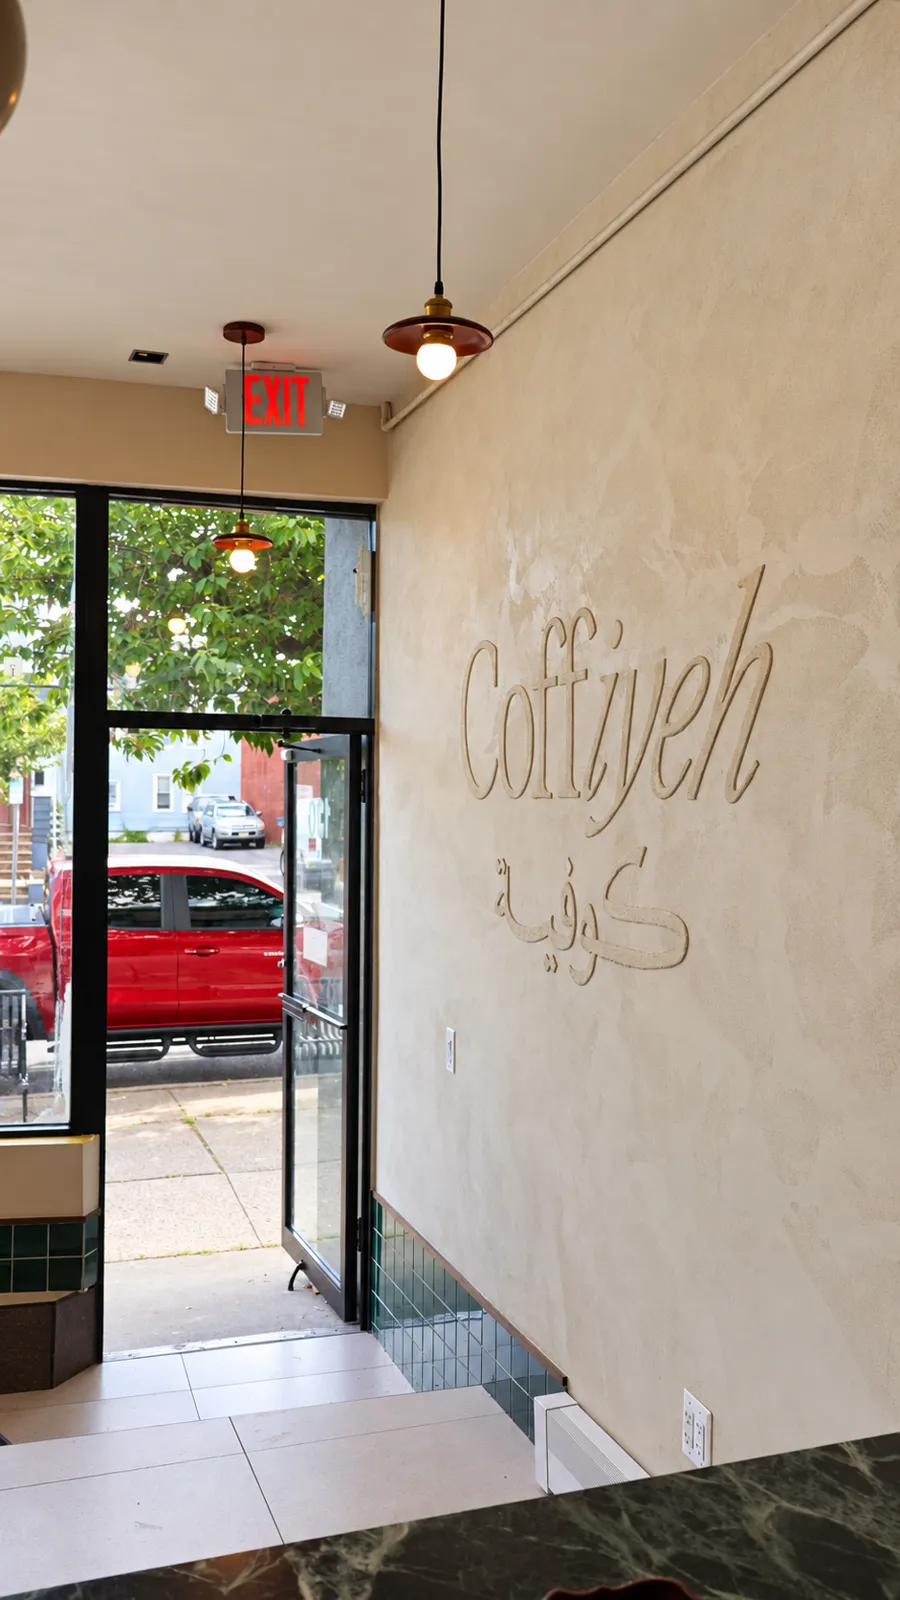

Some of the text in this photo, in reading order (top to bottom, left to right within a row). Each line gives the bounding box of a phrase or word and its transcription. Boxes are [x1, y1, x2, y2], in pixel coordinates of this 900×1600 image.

[243, 374, 309, 427] EXIT
[460, 563, 774, 838] Coffiyeh
[495, 845, 690, 987] كوفية
